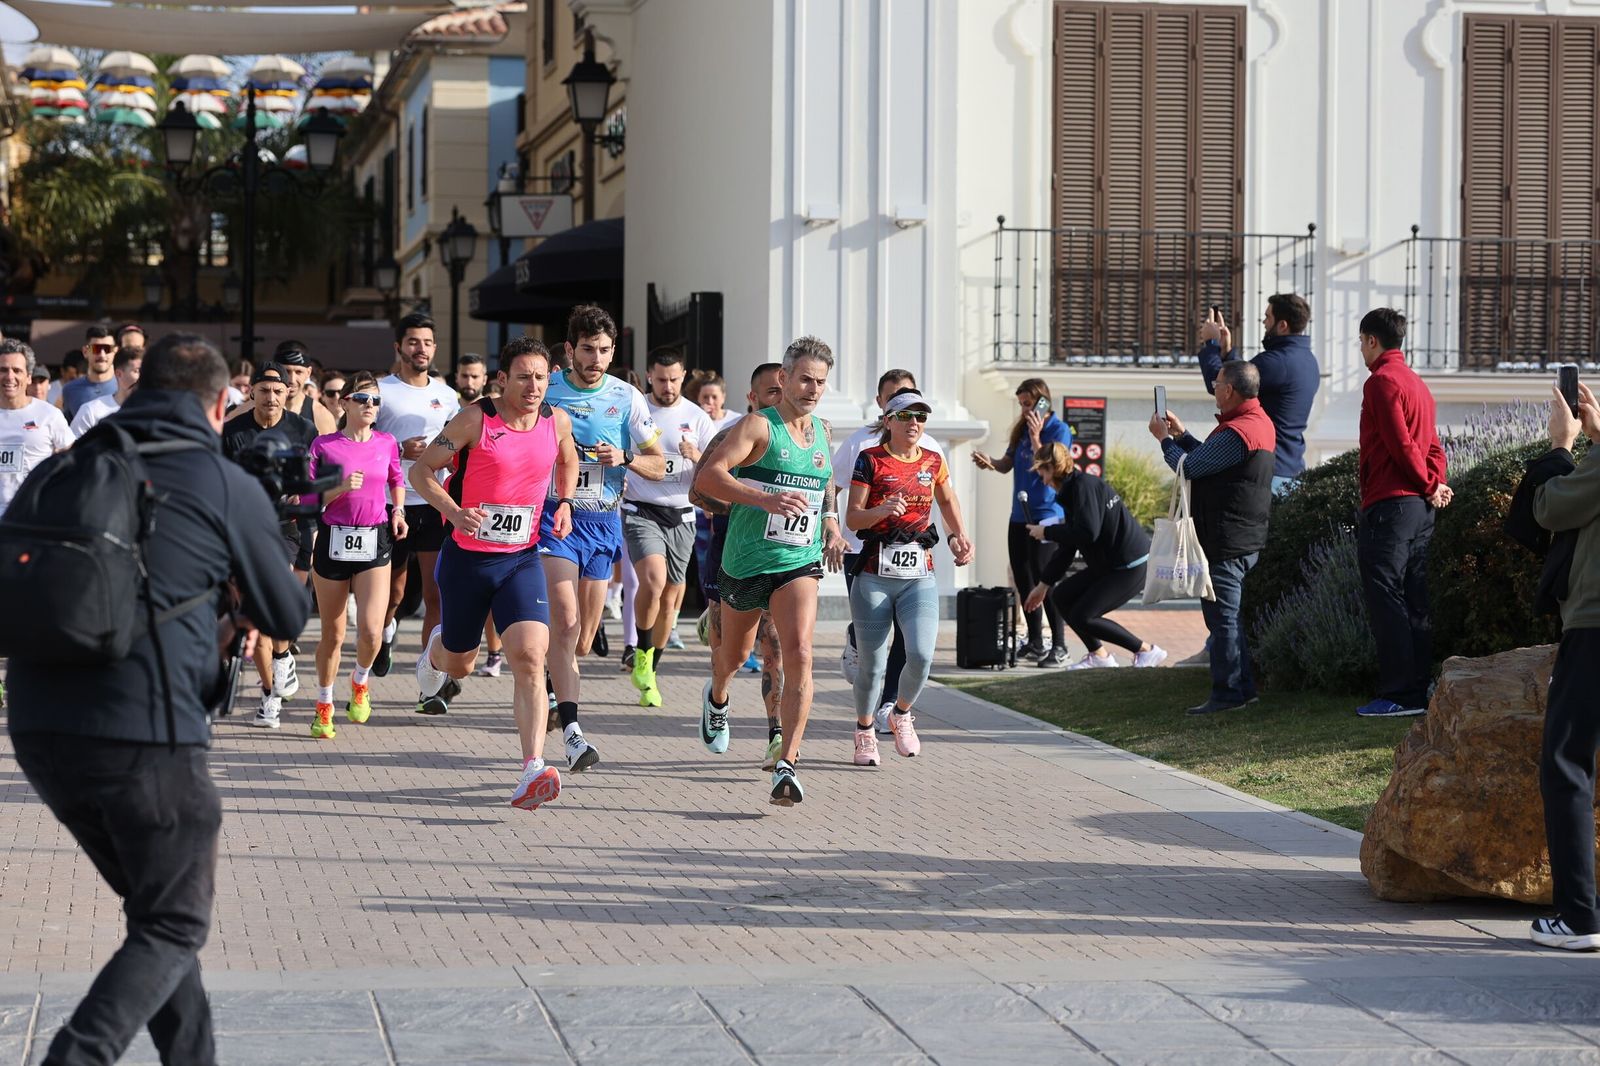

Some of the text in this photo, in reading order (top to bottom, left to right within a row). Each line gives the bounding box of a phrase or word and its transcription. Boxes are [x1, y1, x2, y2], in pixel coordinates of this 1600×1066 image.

[774, 473, 820, 489] ATLETISMO
[490, 513, 522, 532] 240
[784, 514, 809, 533] 179
[344, 535, 363, 550] 84
[891, 551, 918, 567] 425
